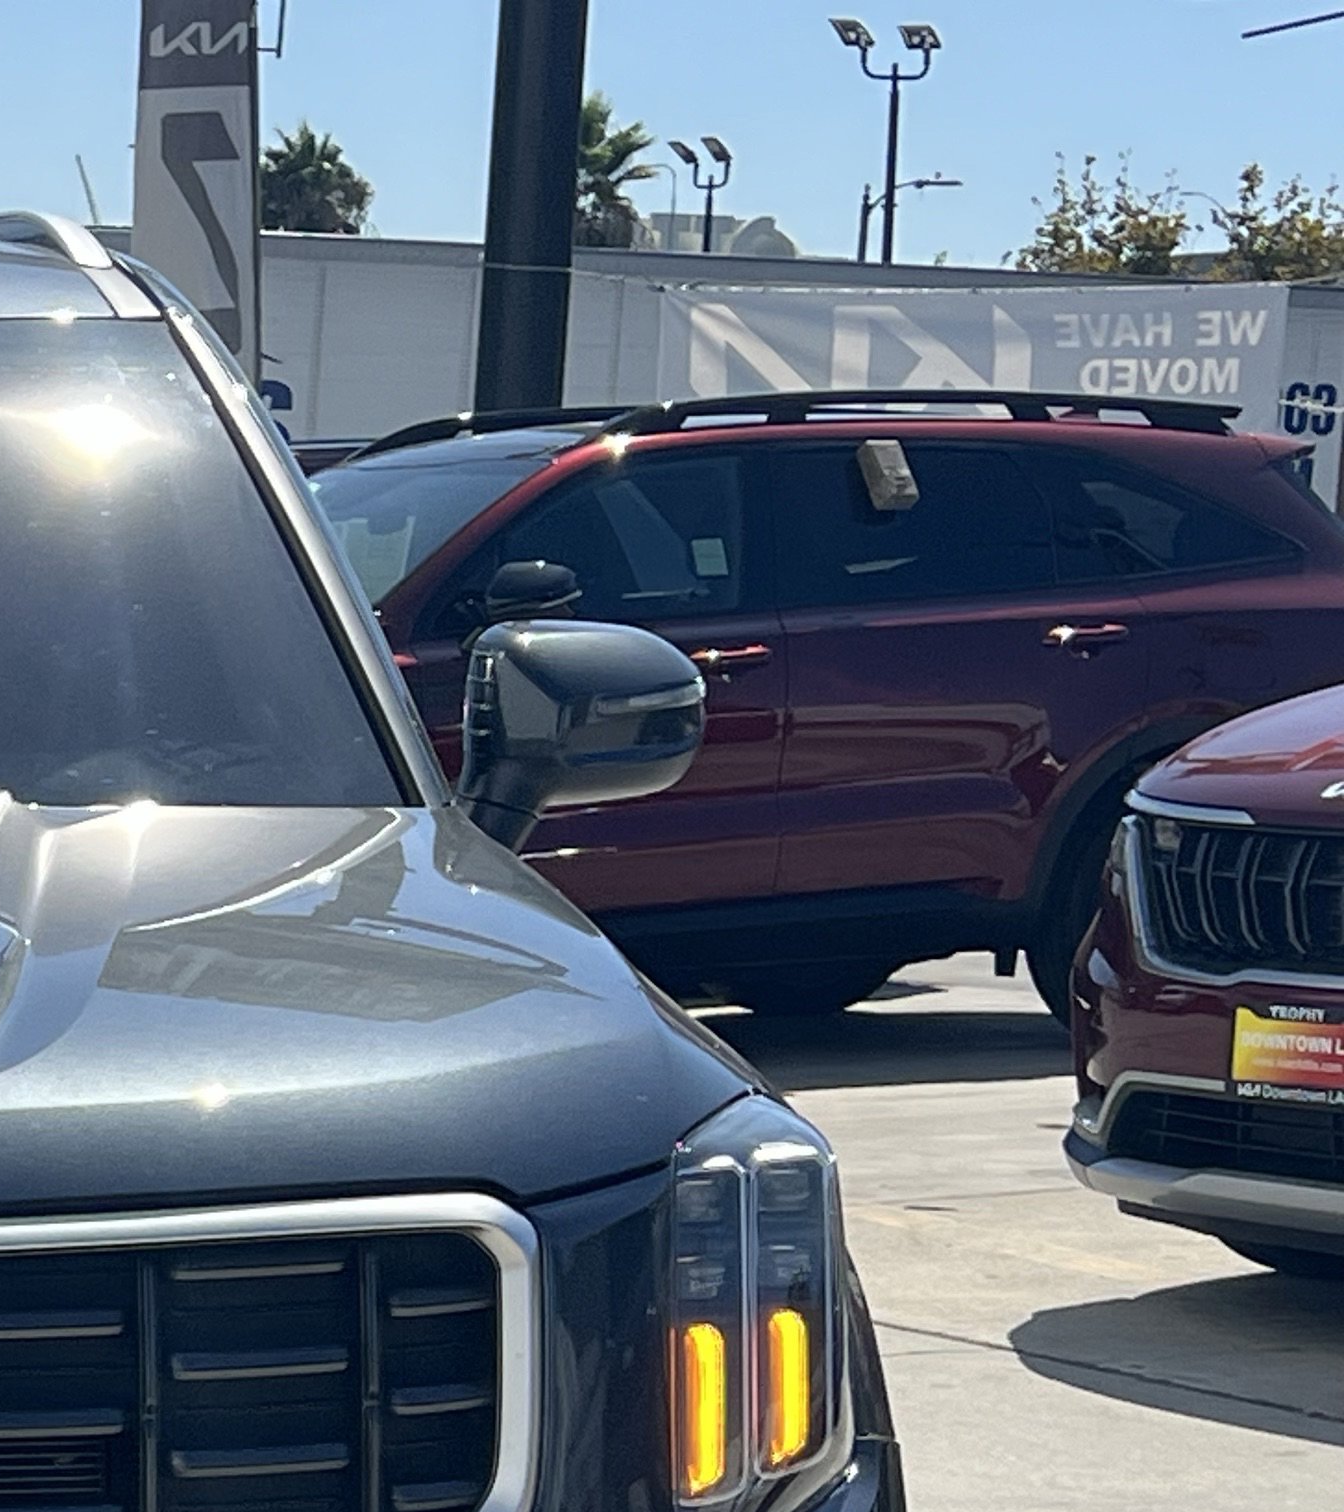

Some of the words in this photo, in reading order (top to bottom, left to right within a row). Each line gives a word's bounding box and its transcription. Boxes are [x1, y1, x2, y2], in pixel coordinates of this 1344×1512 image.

[148, 20, 250, 58] KIA
[1268, 1004, 1326, 1022] TROPHY
[1241, 1031, 1333, 1055] DOWNTOWN
